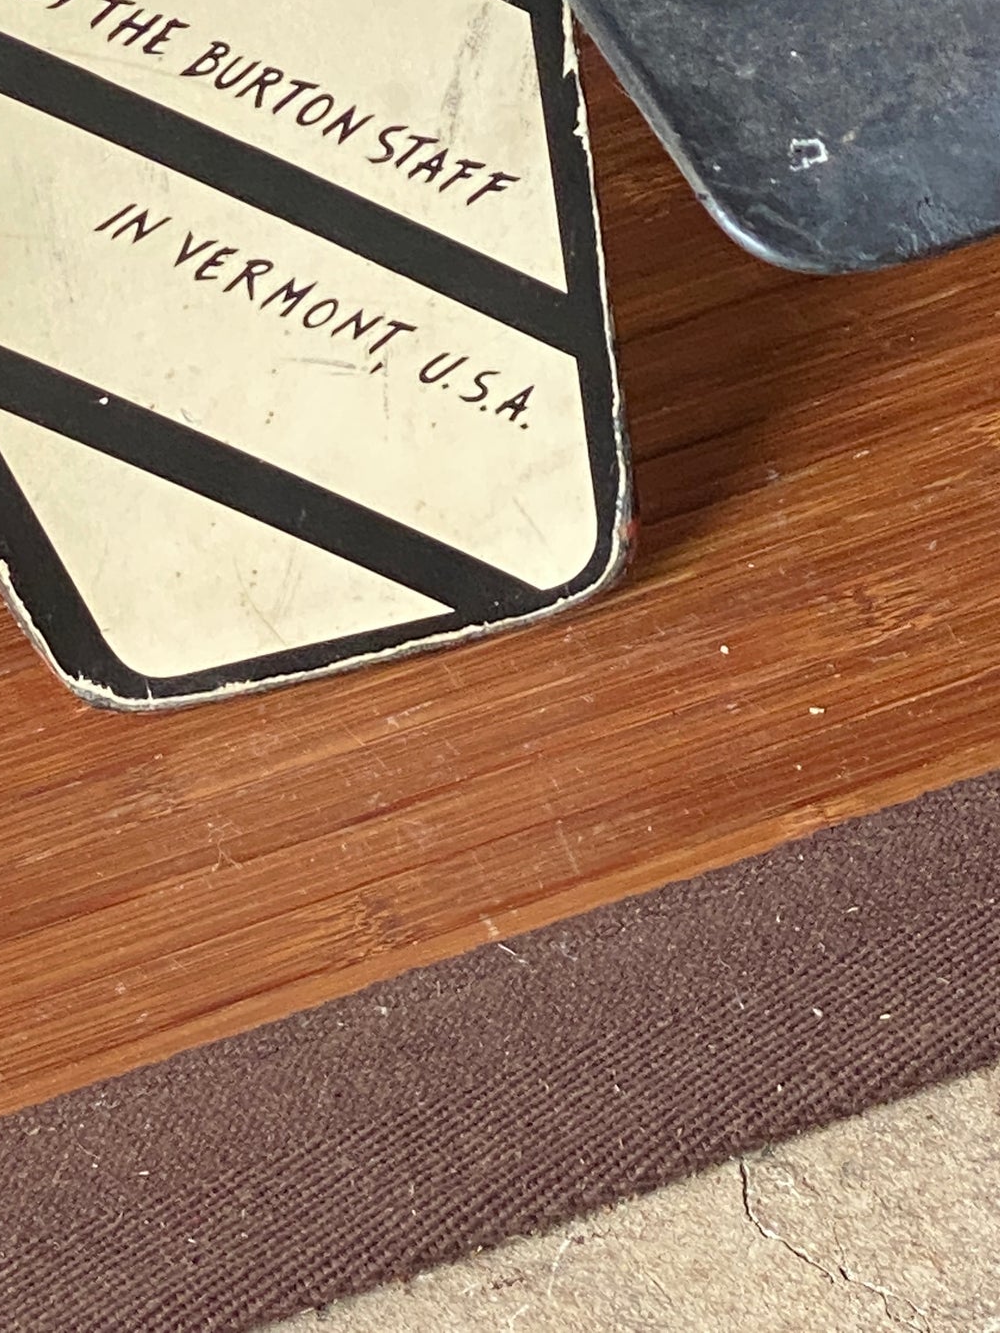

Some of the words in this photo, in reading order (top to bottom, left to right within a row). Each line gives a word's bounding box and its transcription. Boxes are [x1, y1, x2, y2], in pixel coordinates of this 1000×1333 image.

[179, 41, 374, 145] BURTON
[368, 125, 521, 206] STAFF
[94, 203, 172, 244] IN
[174, 230, 417, 374] VERMONT,
[418, 352, 534, 430] U.S.A.
